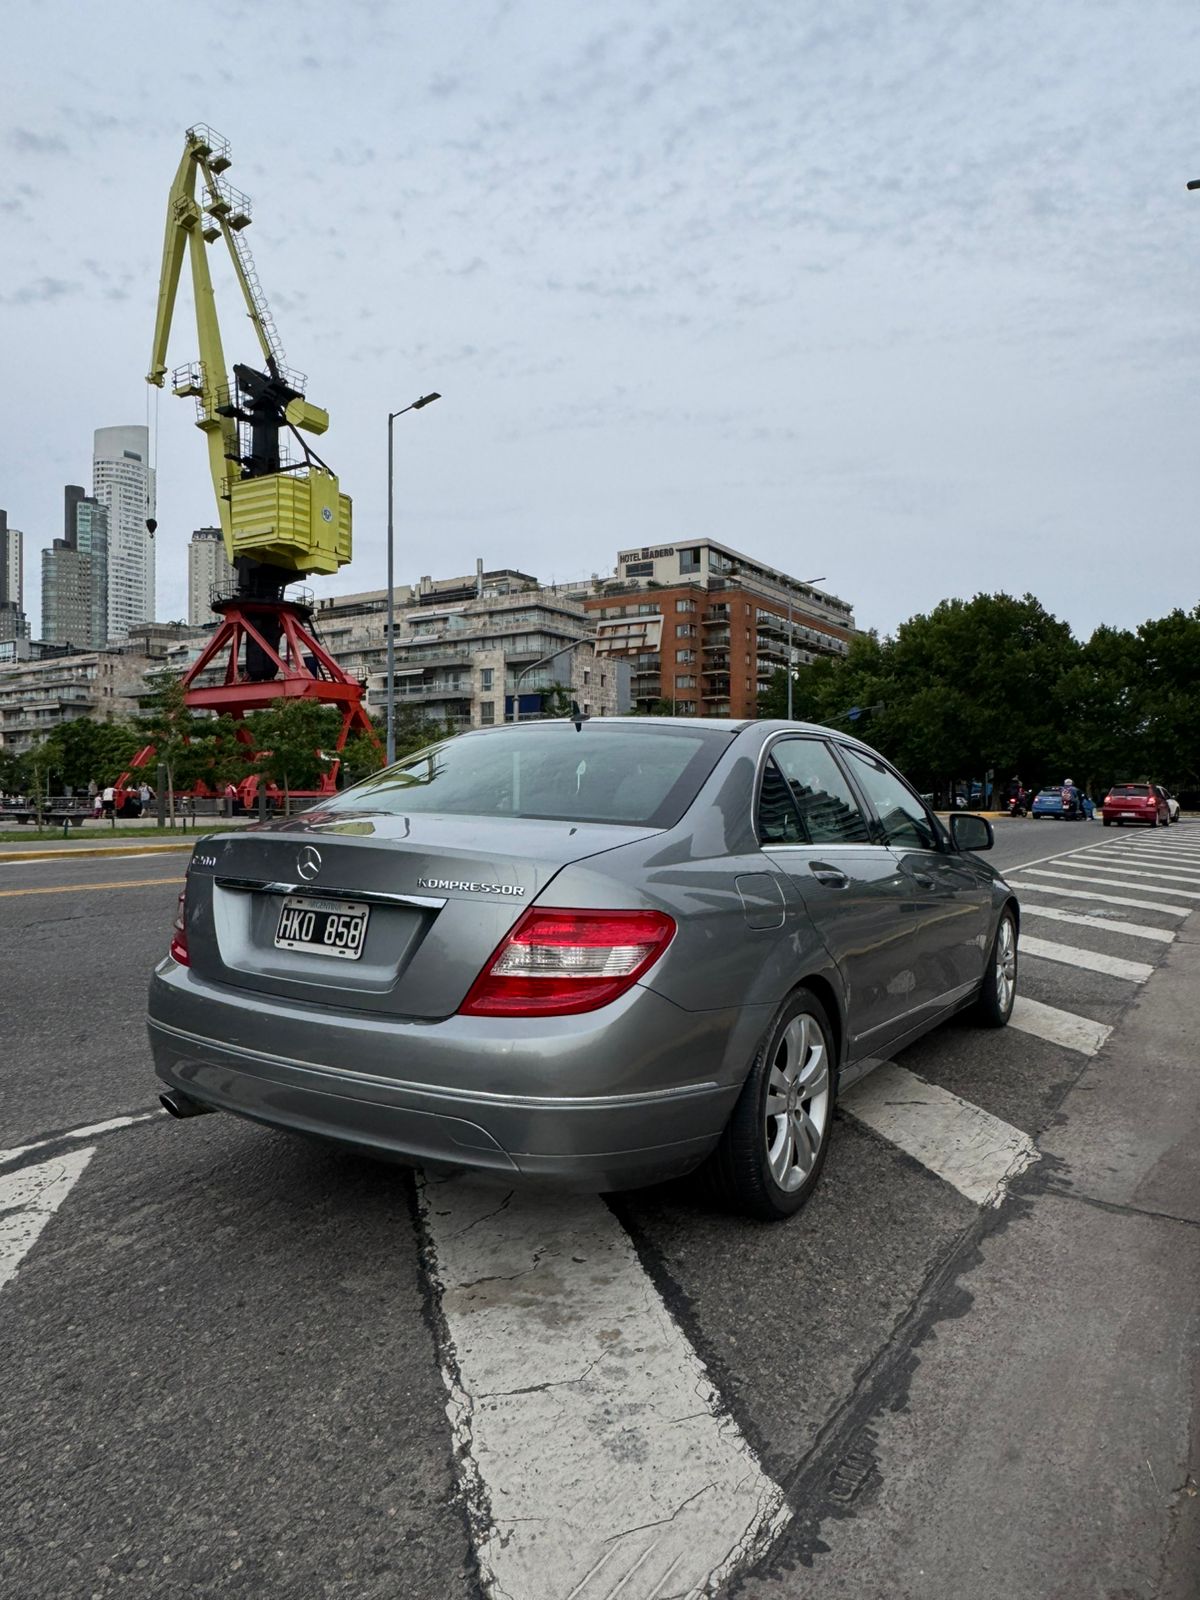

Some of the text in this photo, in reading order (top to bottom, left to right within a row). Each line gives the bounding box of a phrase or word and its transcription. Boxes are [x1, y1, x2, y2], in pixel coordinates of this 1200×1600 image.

[620, 548, 674, 563] HOTEL MADERO
[417, 878, 525, 896] KOMPRESSOR
[279, 909, 362, 948] HKO 858
